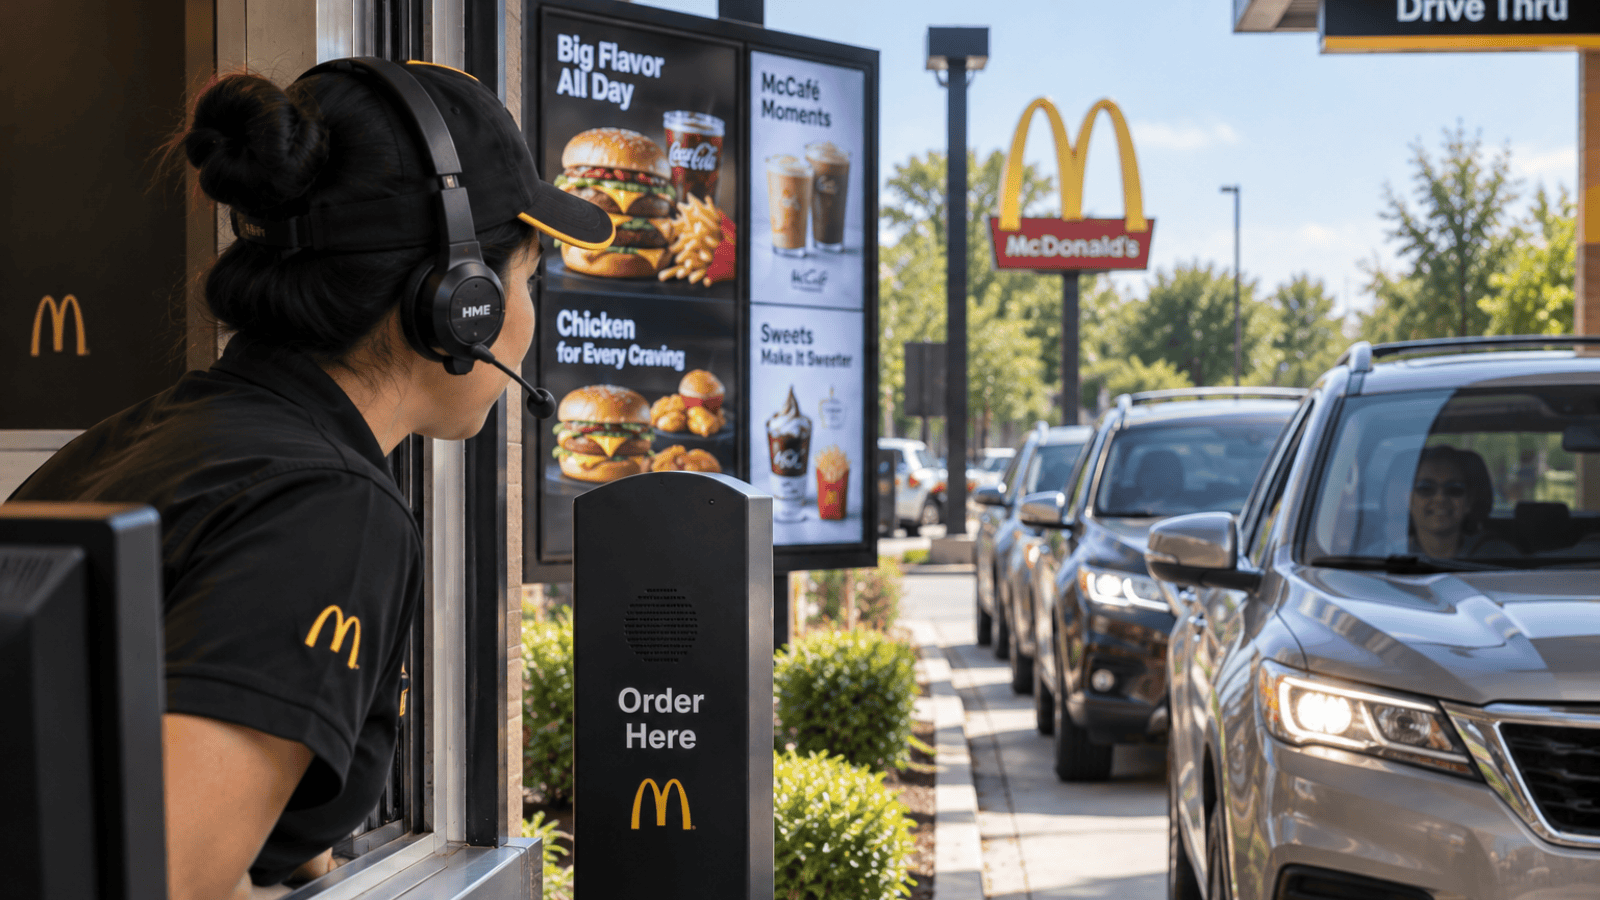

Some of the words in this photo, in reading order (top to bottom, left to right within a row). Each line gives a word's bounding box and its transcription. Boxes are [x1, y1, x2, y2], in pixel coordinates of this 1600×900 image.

[1397, 0, 1485, 22] Drive
[1497, 0, 1569, 22] Thru
[557, 33, 595, 73] Big
[598, 40, 665, 79] Flavor
[556, 67, 588, 99] All
[591, 71, 635, 111] Day
[761, 72, 820, 101] McCafé
[761, 99, 832, 128] Moments
[1005, 234, 1140, 258] McDonald's
[462, 304, 491, 318] HME
[556, 309, 636, 340] Chicken
[761, 323, 813, 345] Sweets
[556, 340, 582, 364] for
[582, 342, 627, 370] Every
[628, 344, 686, 372] Craving
[761, 348, 792, 366] Make
[795, 350, 804, 366] It
[807, 350, 853, 368] Sweeter
[618, 687, 705, 714] Order
[626, 722, 697, 750] Here
